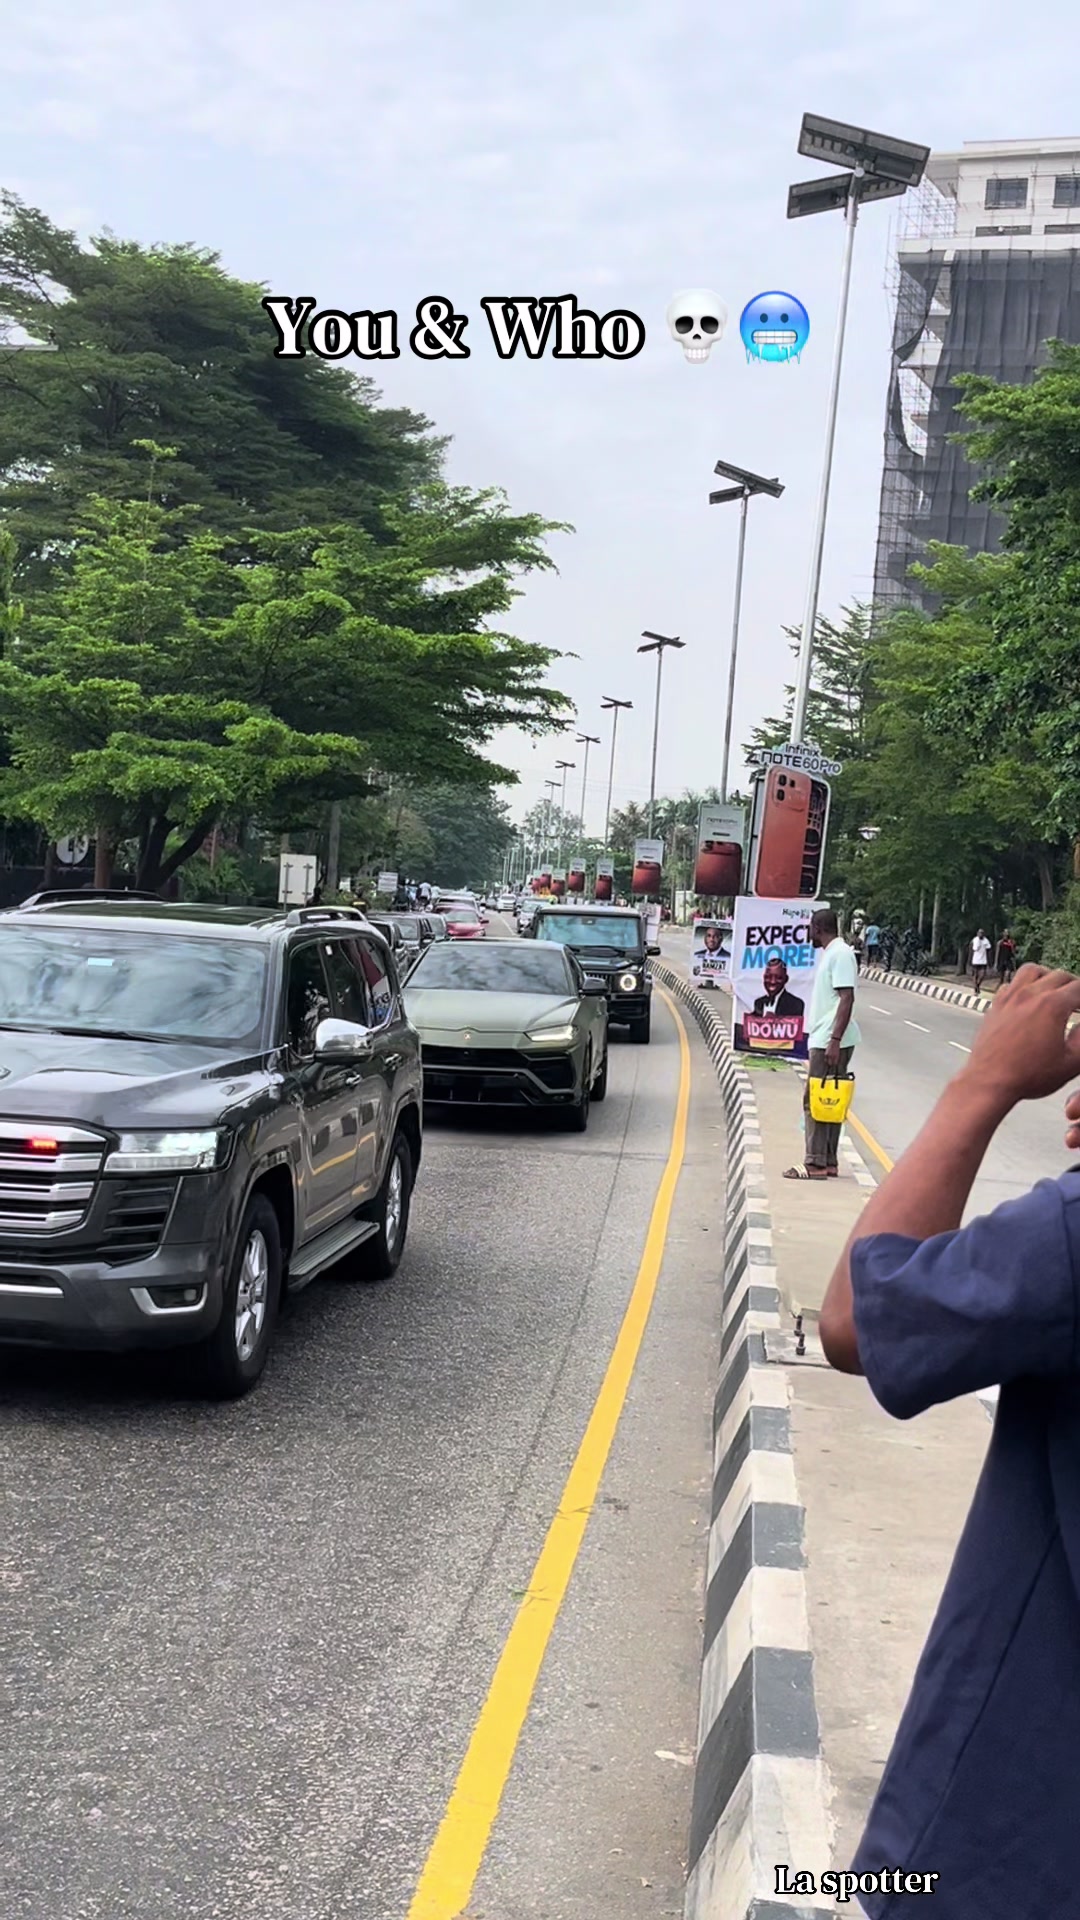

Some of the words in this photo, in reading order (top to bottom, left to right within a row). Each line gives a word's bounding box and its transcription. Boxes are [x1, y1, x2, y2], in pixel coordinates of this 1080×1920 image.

[785, 744, 820, 757] Infinix
[745, 924, 811, 946] EXPECT
[741, 944, 816, 970] MORE!
[747, 1021, 799, 1039] IDOWU
